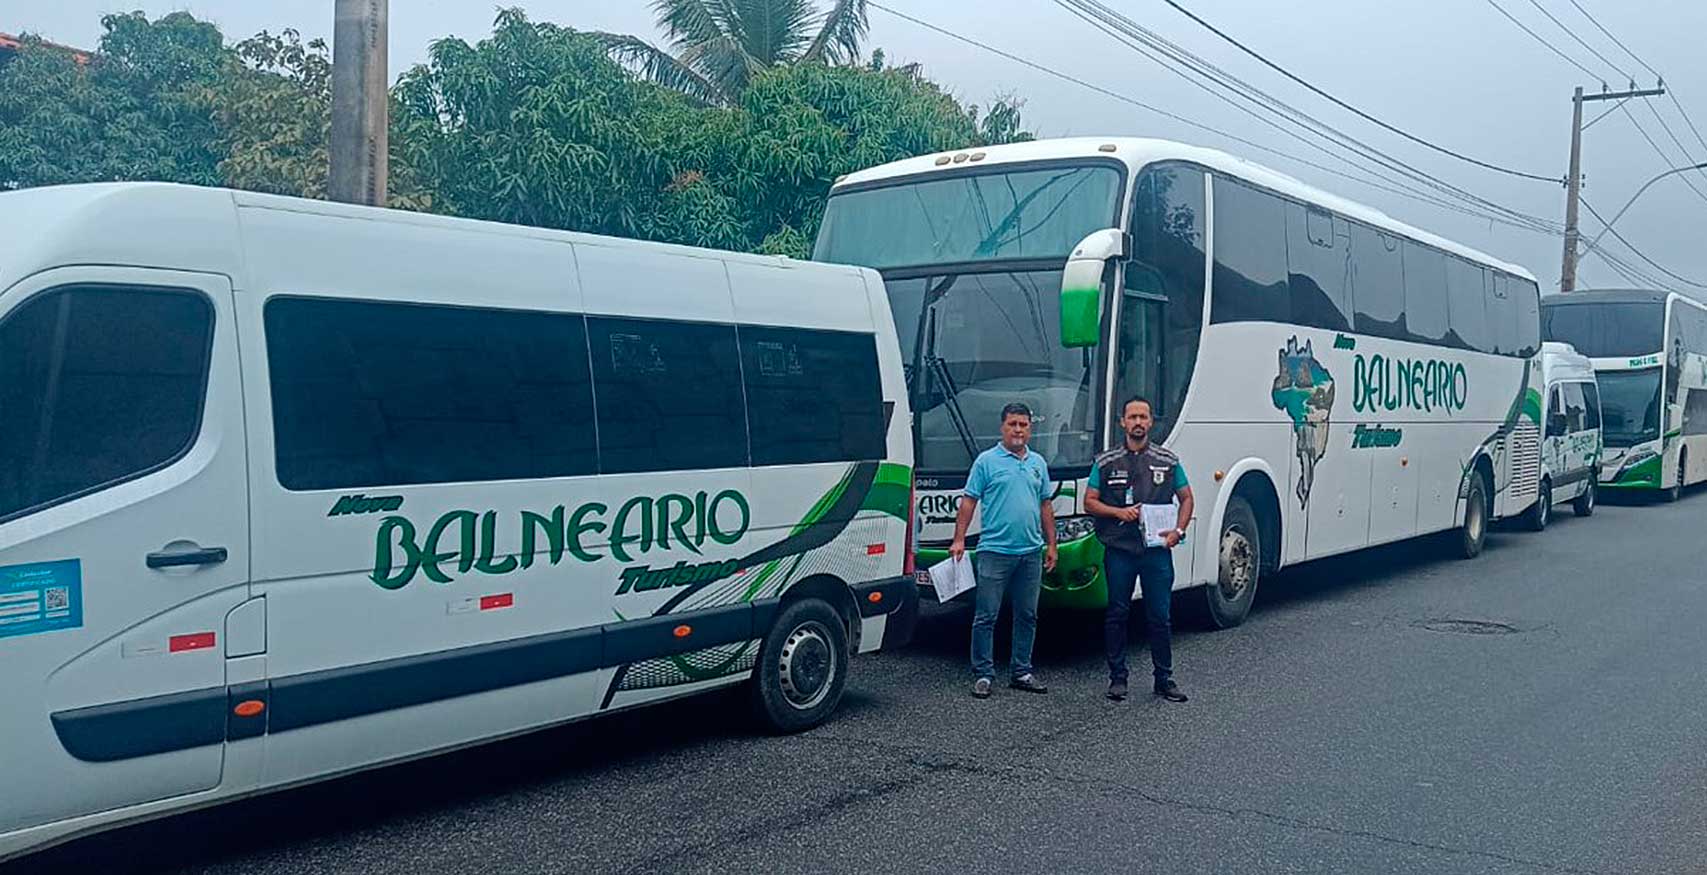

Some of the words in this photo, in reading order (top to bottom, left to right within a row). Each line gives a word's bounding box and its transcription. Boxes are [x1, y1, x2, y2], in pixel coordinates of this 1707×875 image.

[1353, 354, 1467, 416] BALNEARIO
[1352, 424, 1402, 449] Turismo
[327, 494, 404, 517] Nova
[368, 489, 750, 590] BALNEARIO
[614, 558, 741, 596] Turismo
